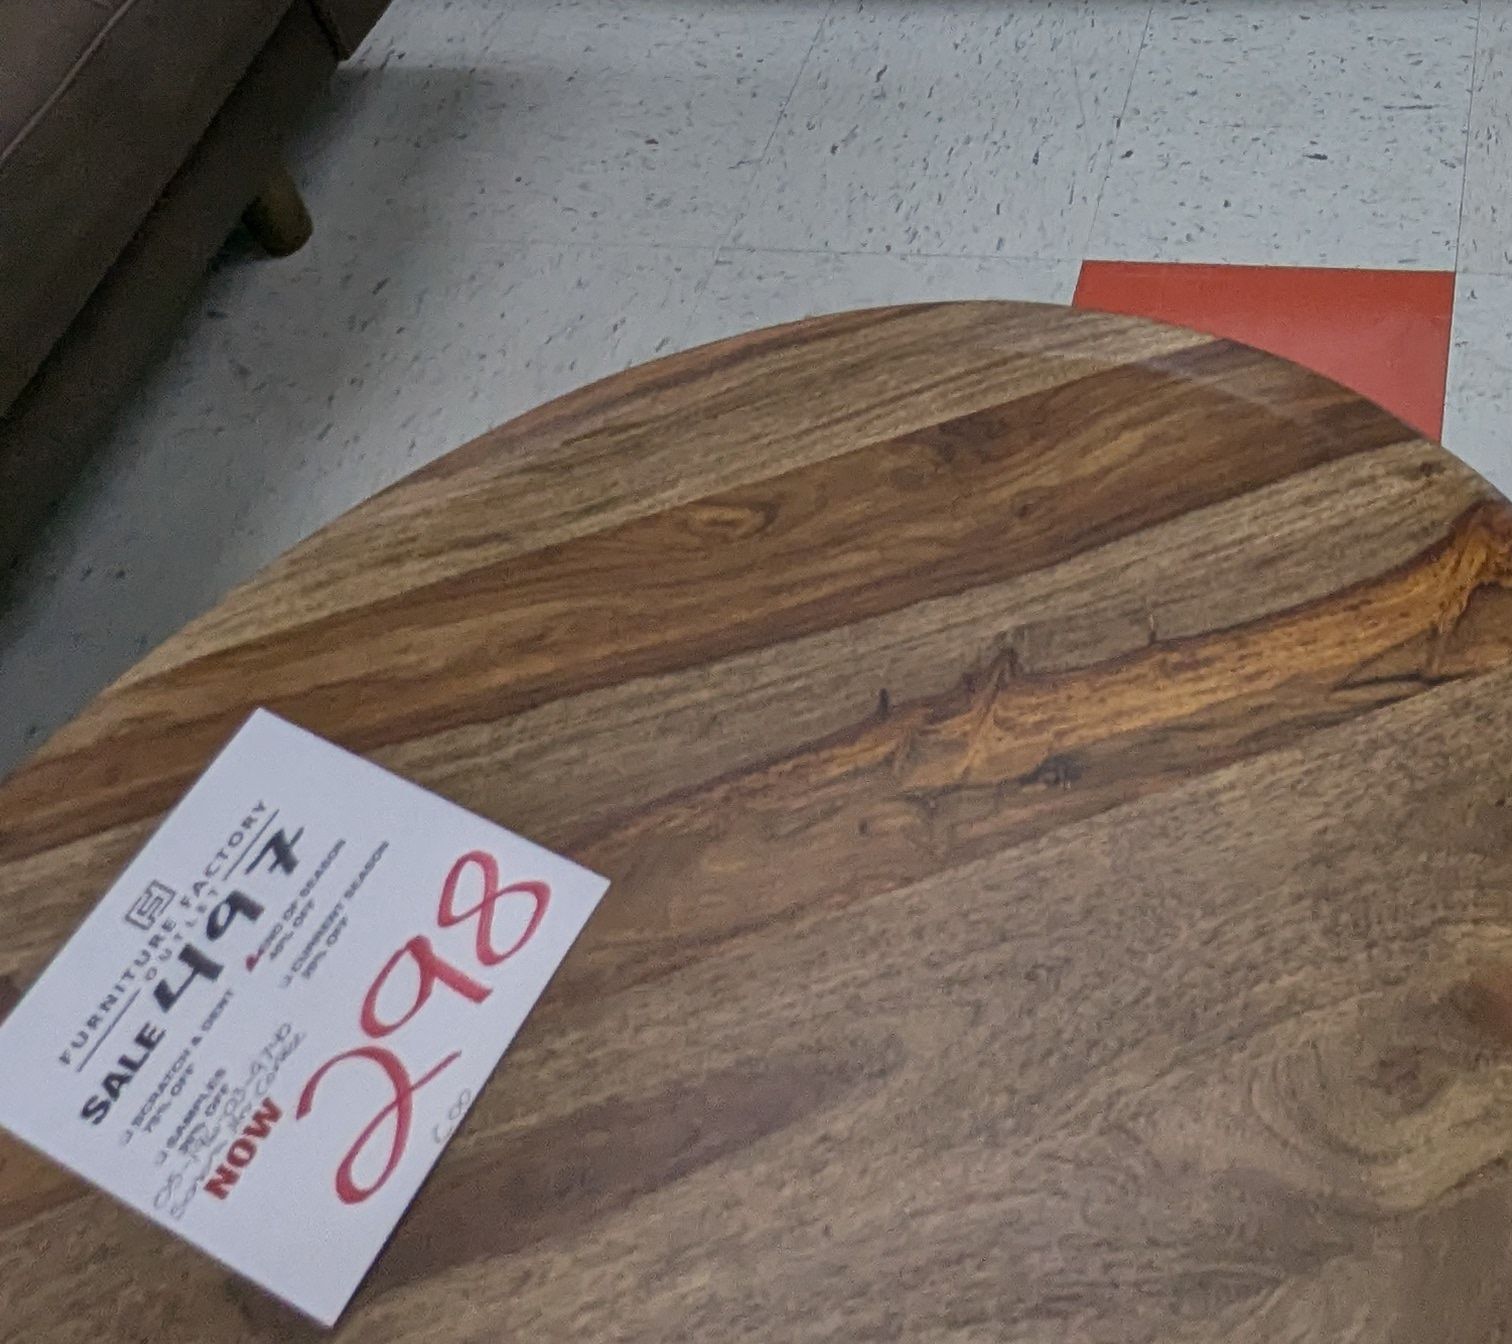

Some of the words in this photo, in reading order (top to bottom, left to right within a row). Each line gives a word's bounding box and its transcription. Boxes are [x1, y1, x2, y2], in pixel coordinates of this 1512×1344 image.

[59, 919, 177, 1065] FURNITURE
[179, 800, 267, 909] FACTORY
[299, 837, 346, 898] SEASON
[80, 1023, 167, 1126] SALE
[153, 827, 304, 1014] 497
[295, 849, 552, 1205] 298
[170, 1062, 194, 1097] OFF
[202, 1096, 284, 1201] NOW
